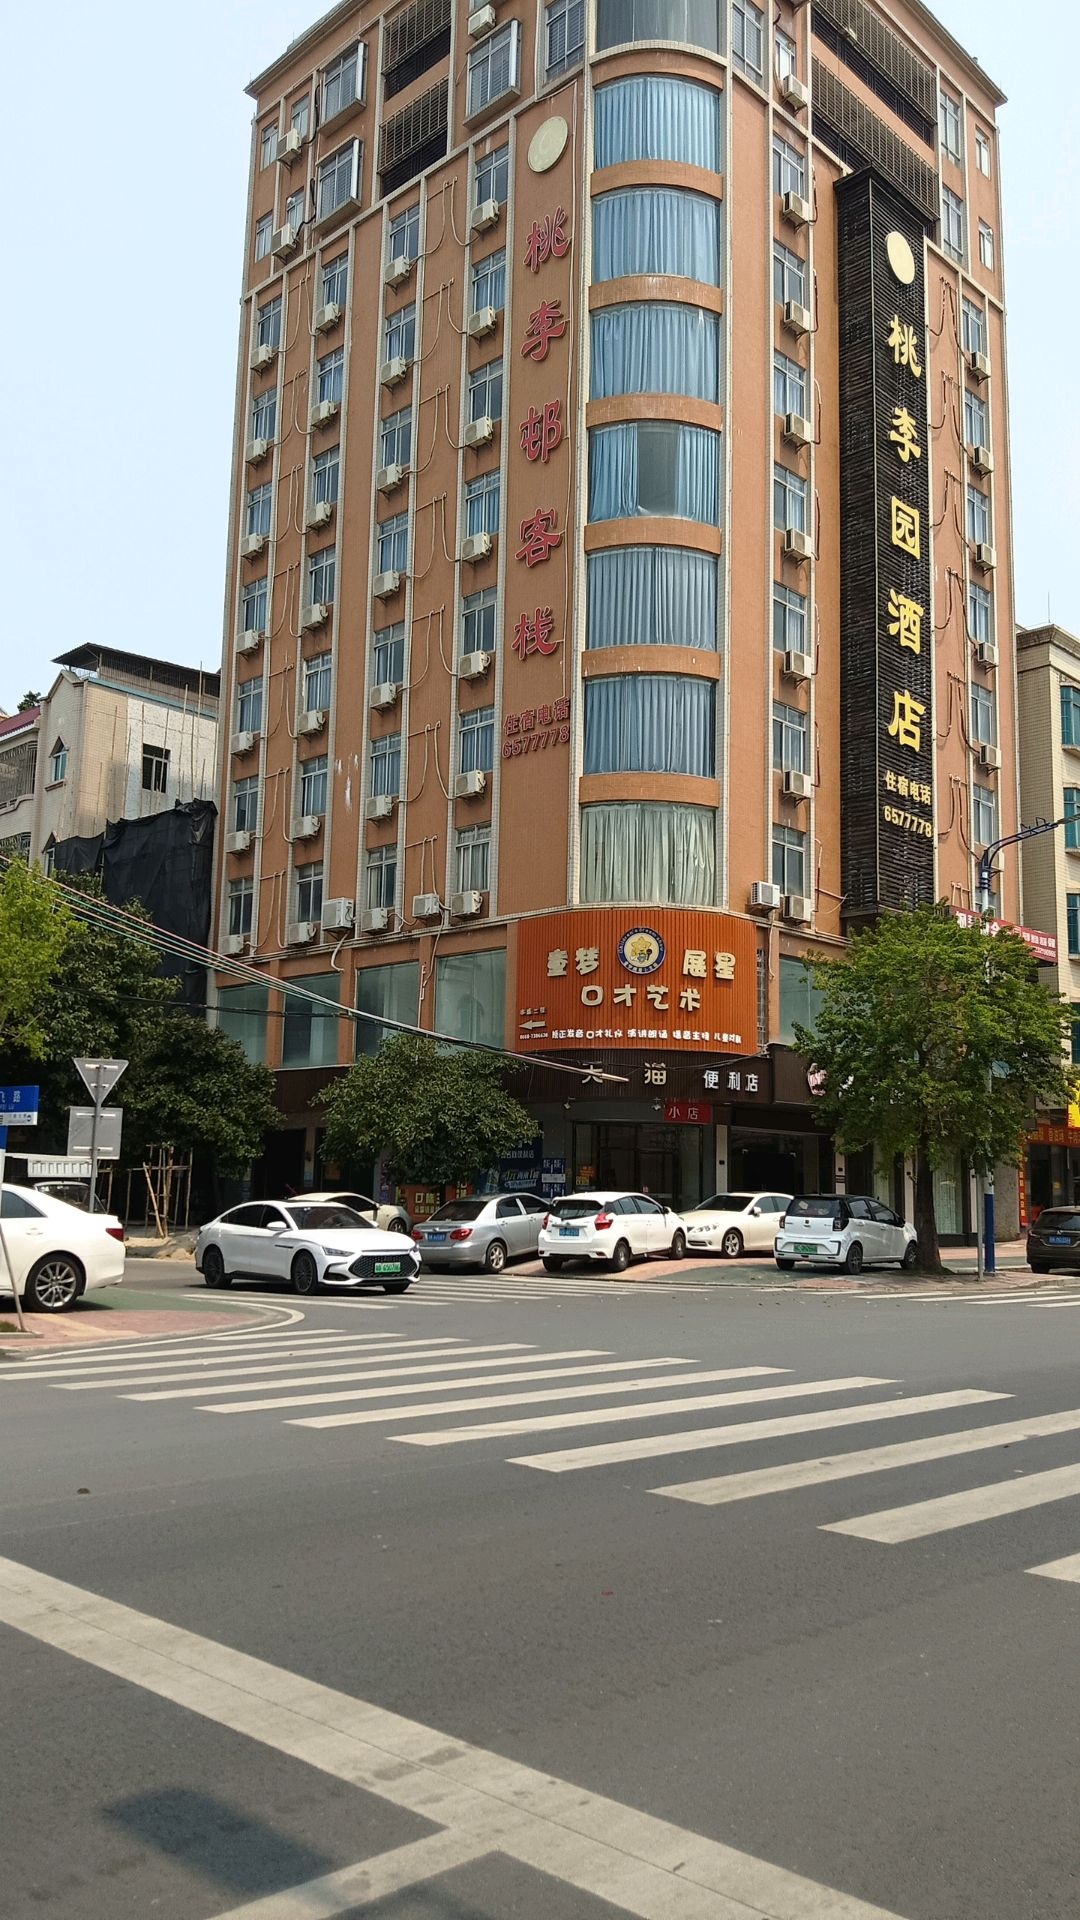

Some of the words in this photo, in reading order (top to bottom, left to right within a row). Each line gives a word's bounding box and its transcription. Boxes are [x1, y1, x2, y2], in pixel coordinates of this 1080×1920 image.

[511, 205, 572, 662] 桃李邨客栈
[886, 313, 928, 753] 桃李园酒店
[502, 697, 571, 737] 住宿电话
[501, 725, 571, 760] 6577778
[884, 769, 932, 806] 住宿电话
[883, 805, 934, 839] 6577778
[547, 945, 600, 977] 童梦
[682, 948, 737, 980] 展星
[580, 983, 702, 1012] 口才艺术
[703, 1069, 760, 1093] 便利店
[668, 1105, 699, 1121] 小店
